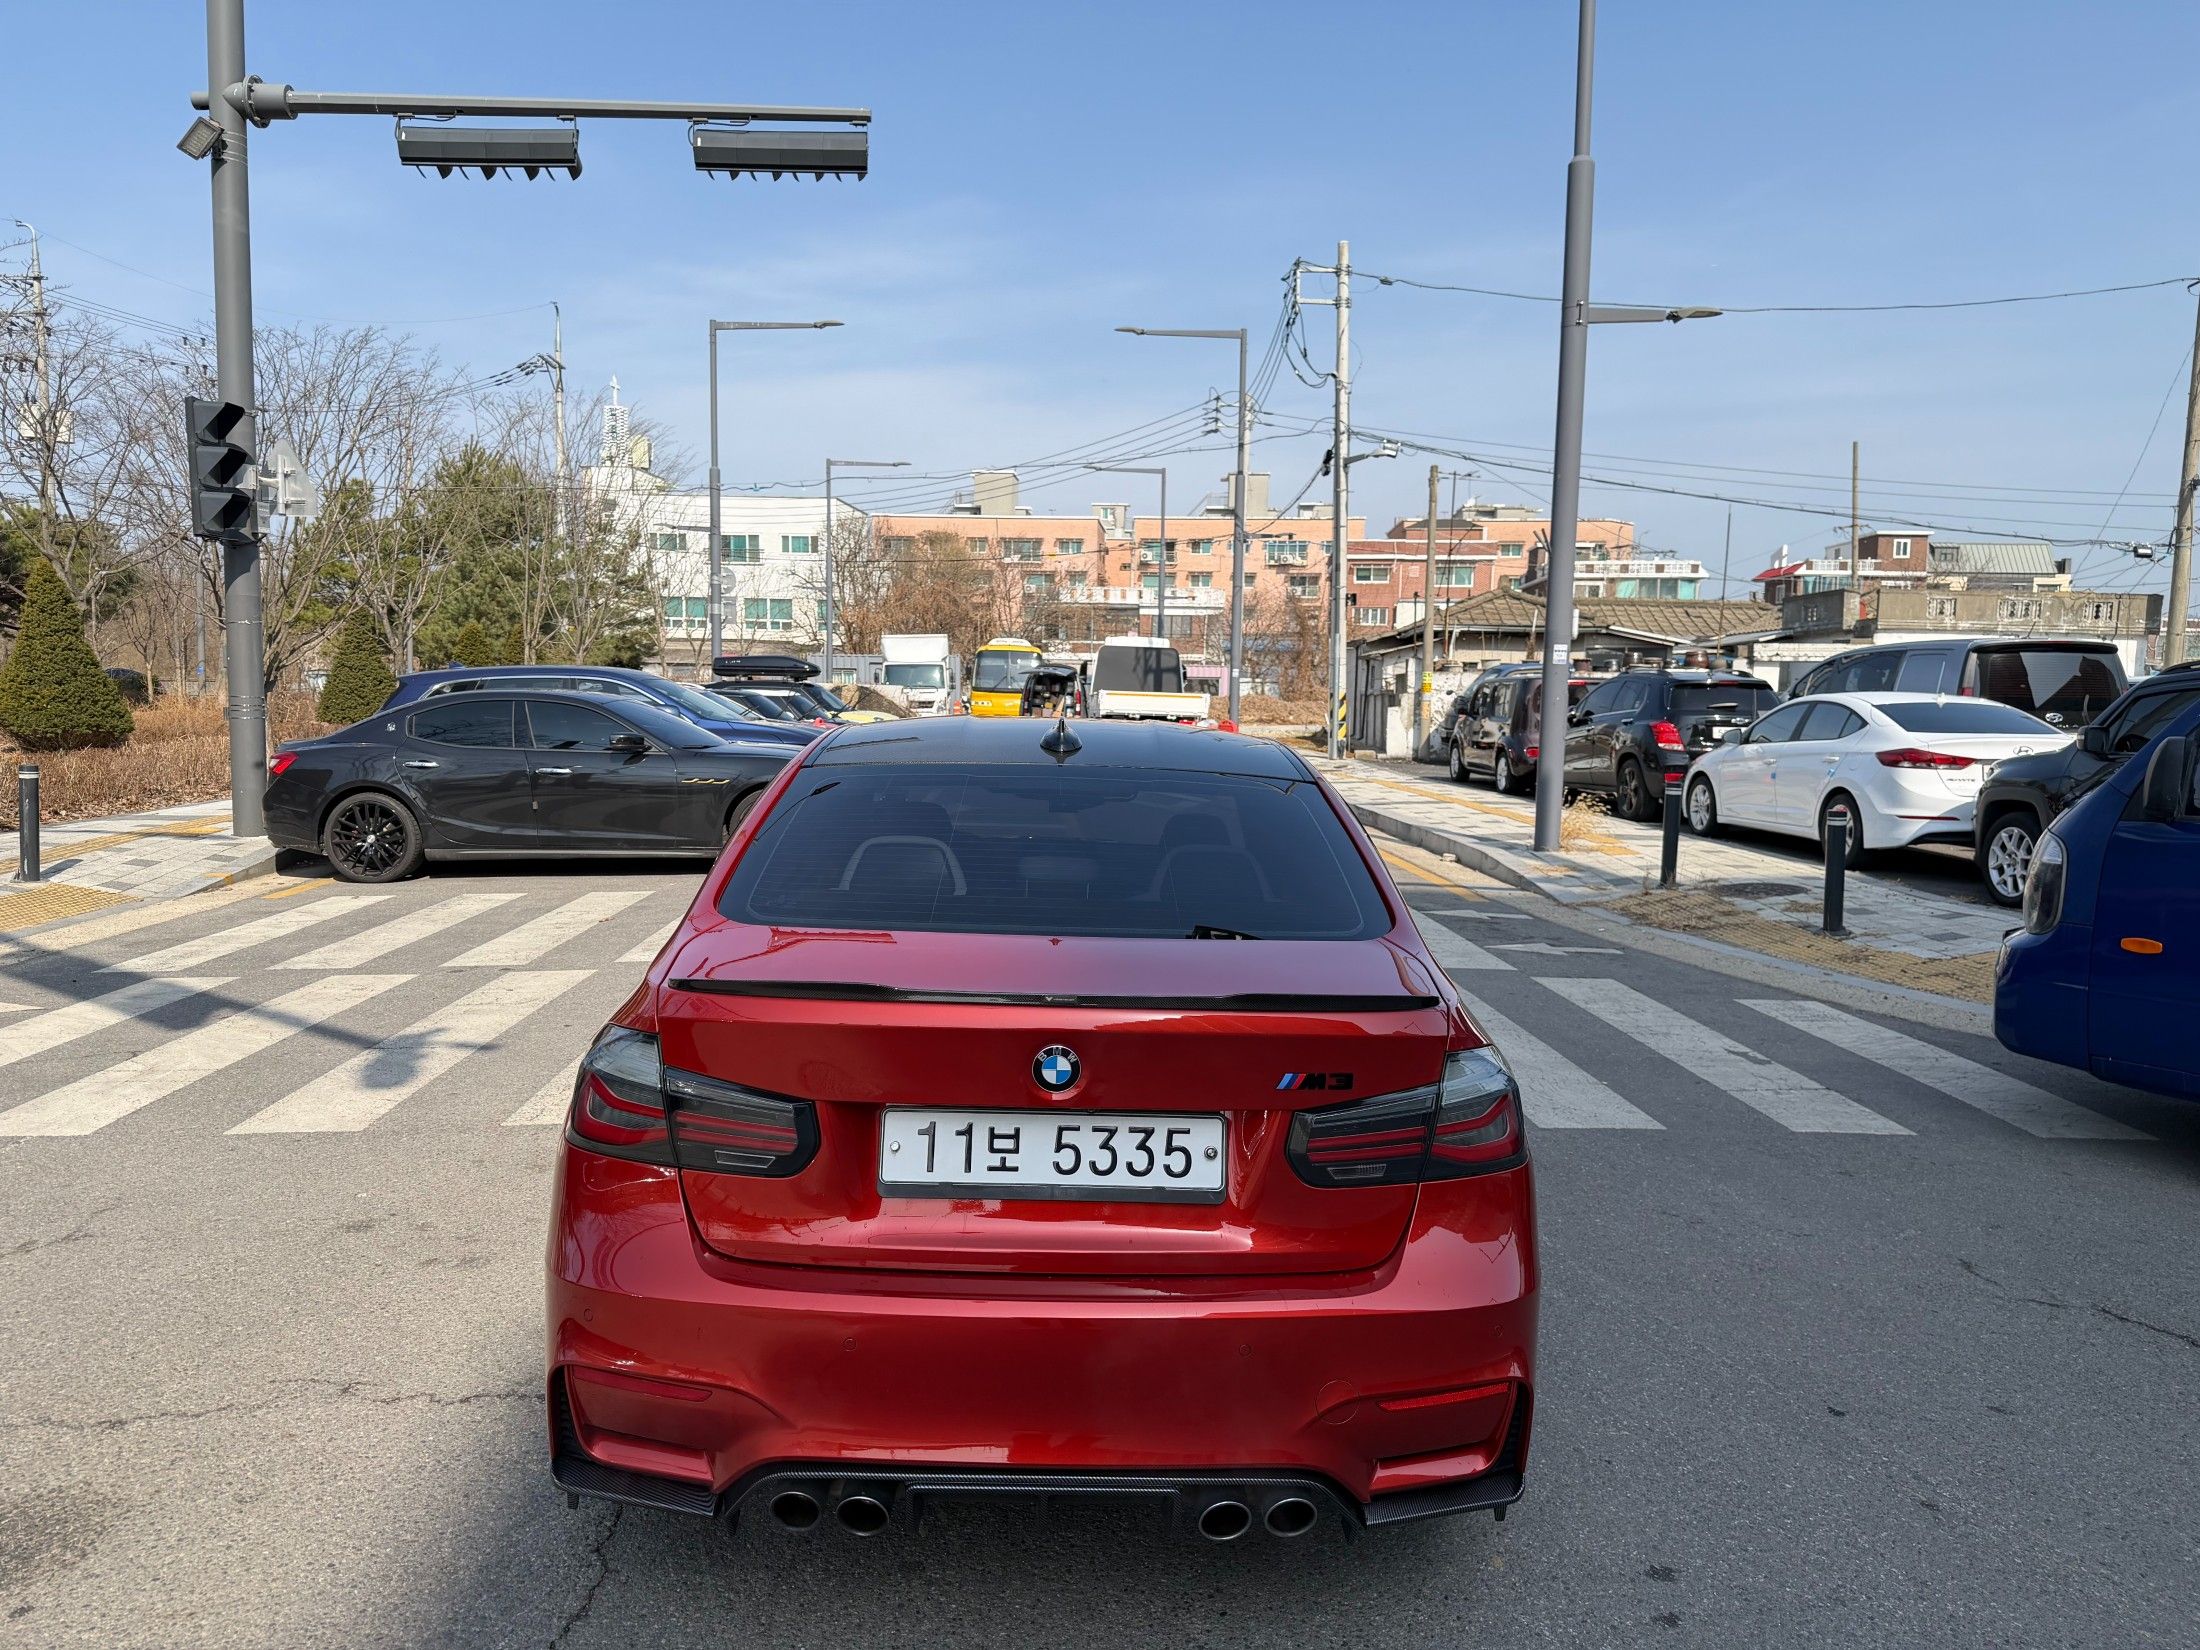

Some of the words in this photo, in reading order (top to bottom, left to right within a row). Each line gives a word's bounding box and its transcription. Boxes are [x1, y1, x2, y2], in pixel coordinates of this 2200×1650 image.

[1037, 1046, 1078, 1063] BMW
[1296, 1072, 1354, 1090] M3
[917, 1121, 1021, 1173] 11보
[1052, 1124, 1193, 1179] 5335
